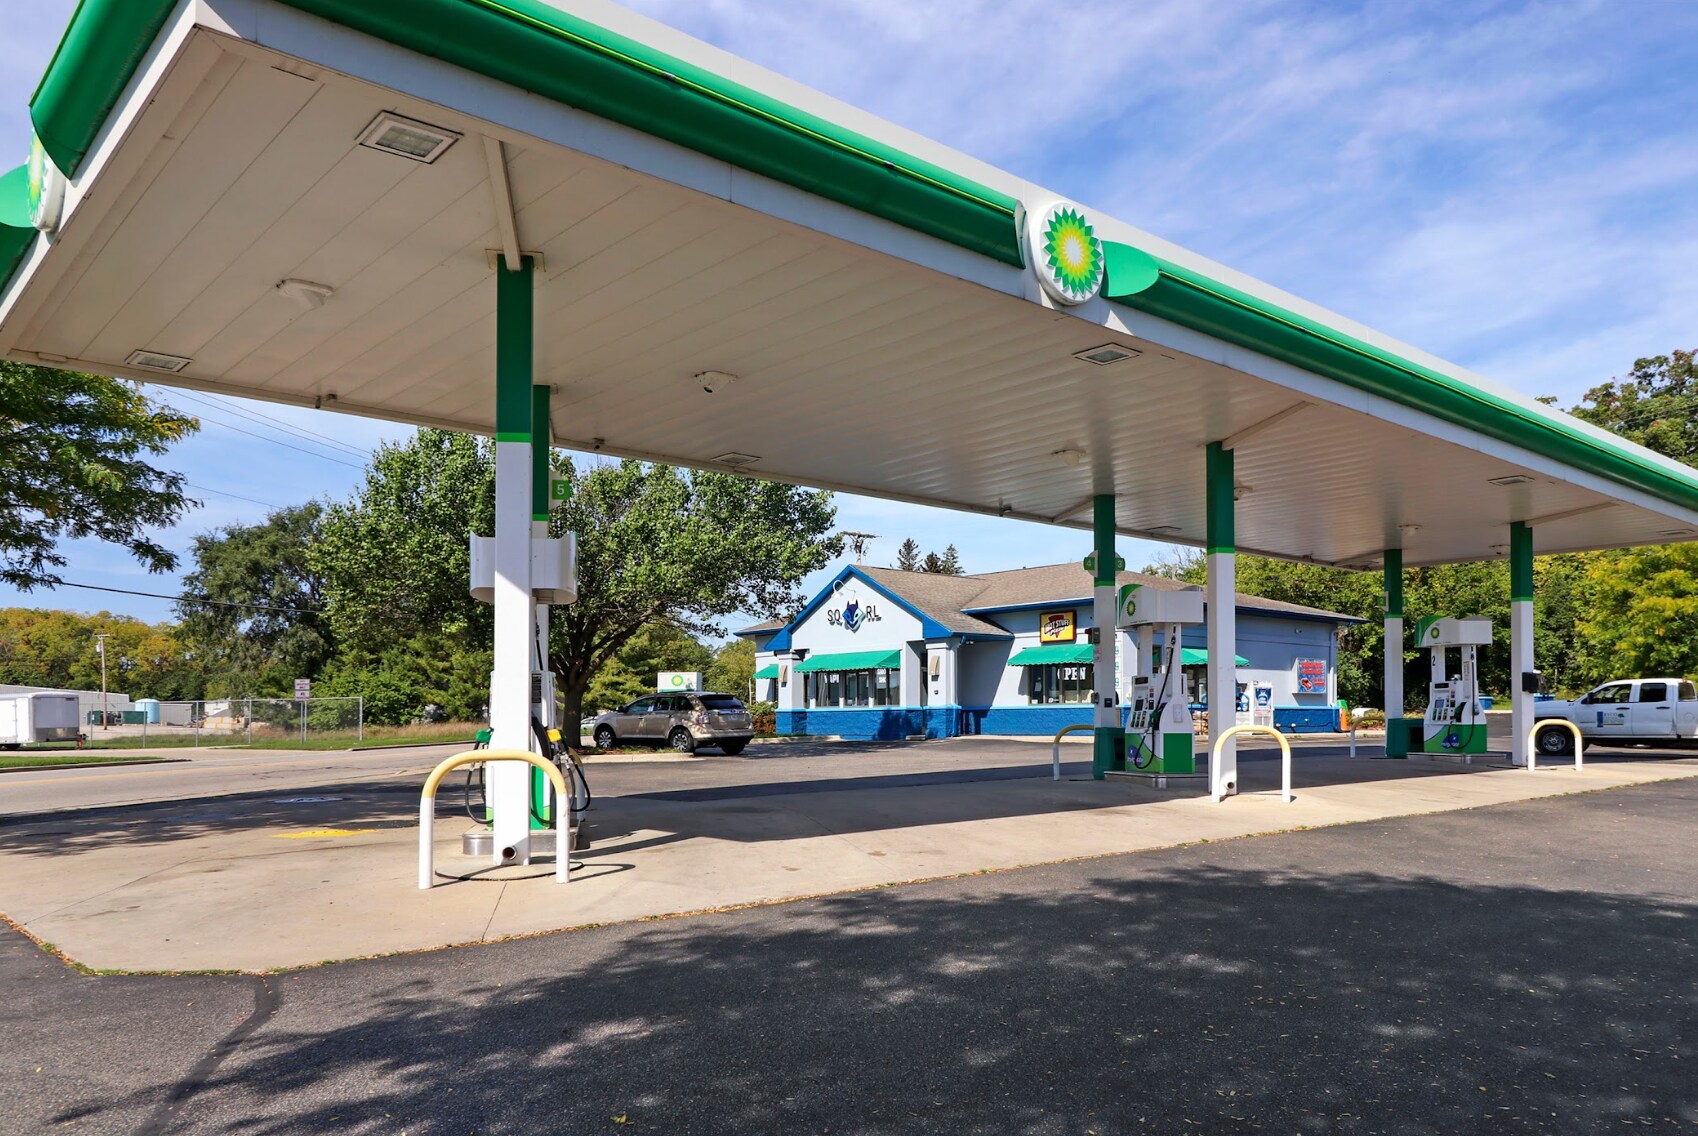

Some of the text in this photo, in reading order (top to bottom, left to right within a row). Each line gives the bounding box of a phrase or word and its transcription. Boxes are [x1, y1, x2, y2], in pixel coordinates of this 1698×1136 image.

[557, 484, 565, 495] 5
[1117, 560, 1123, 568] 3
[1432, 656, 1436, 666] 2
